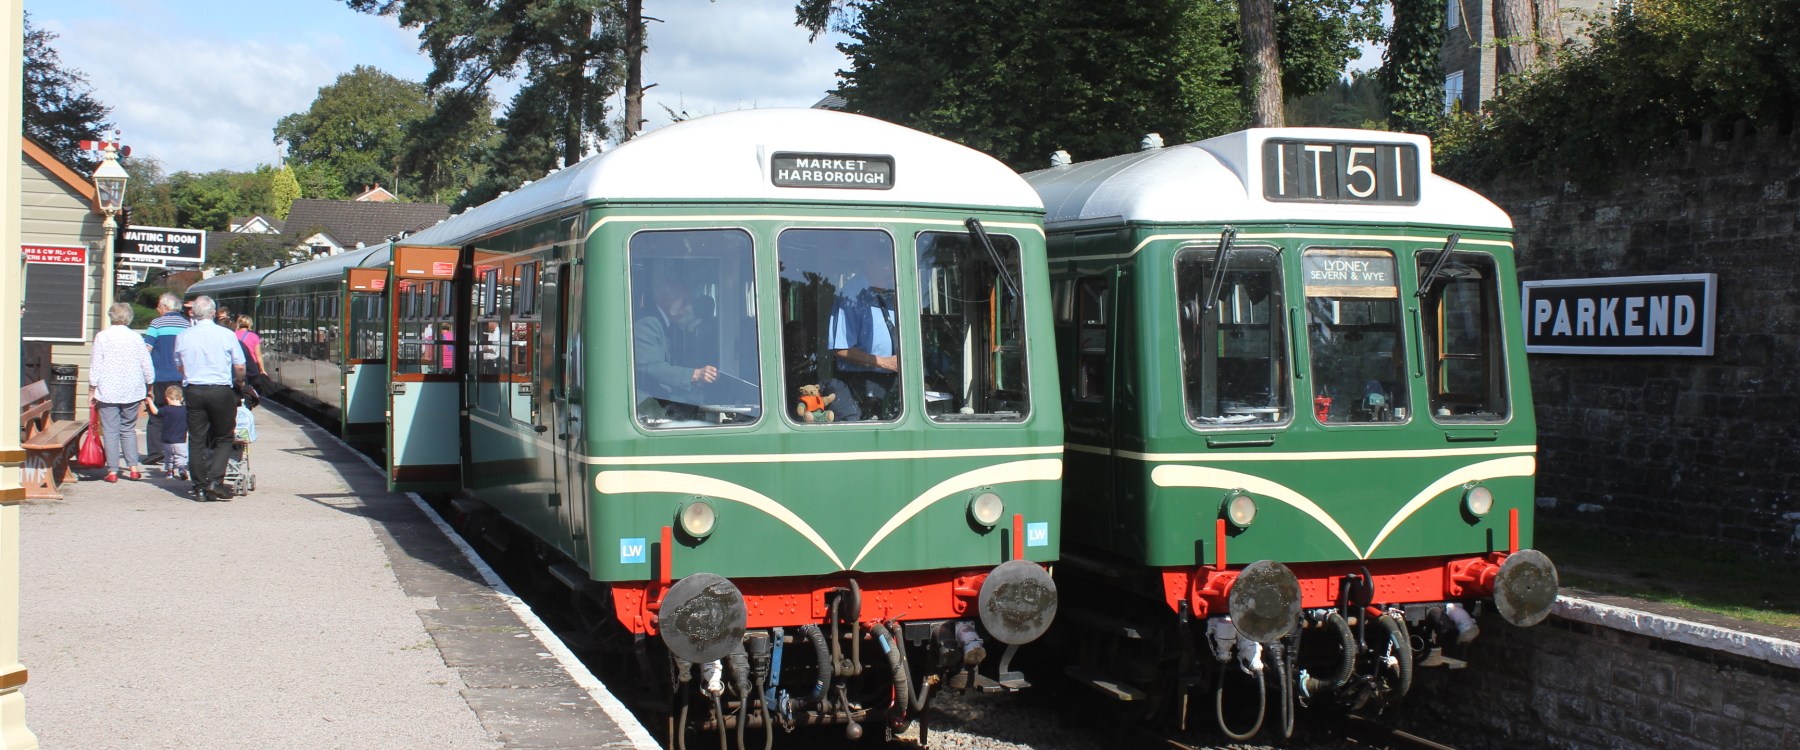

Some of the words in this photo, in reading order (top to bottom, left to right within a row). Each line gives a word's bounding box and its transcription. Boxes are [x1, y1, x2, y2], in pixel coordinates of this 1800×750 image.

[796, 157, 866, 171] MARKET
[778, 169, 884, 184] HARBOROUGH
[124, 231, 163, 242] WAITING
[167, 234, 197, 244] ROOM
[138, 243, 180, 254] TICKETS
[1324, 260, 1370, 272] LYDNEY
[1310, 270, 1347, 281] SEVERN
[1350, 272, 1358, 281] &
[1363, 272, 1385, 282] WYE
[1534, 295, 1695, 336] PARKEND
[1029, 529, 1046, 541] LW
[622, 544, 643, 557] LW
